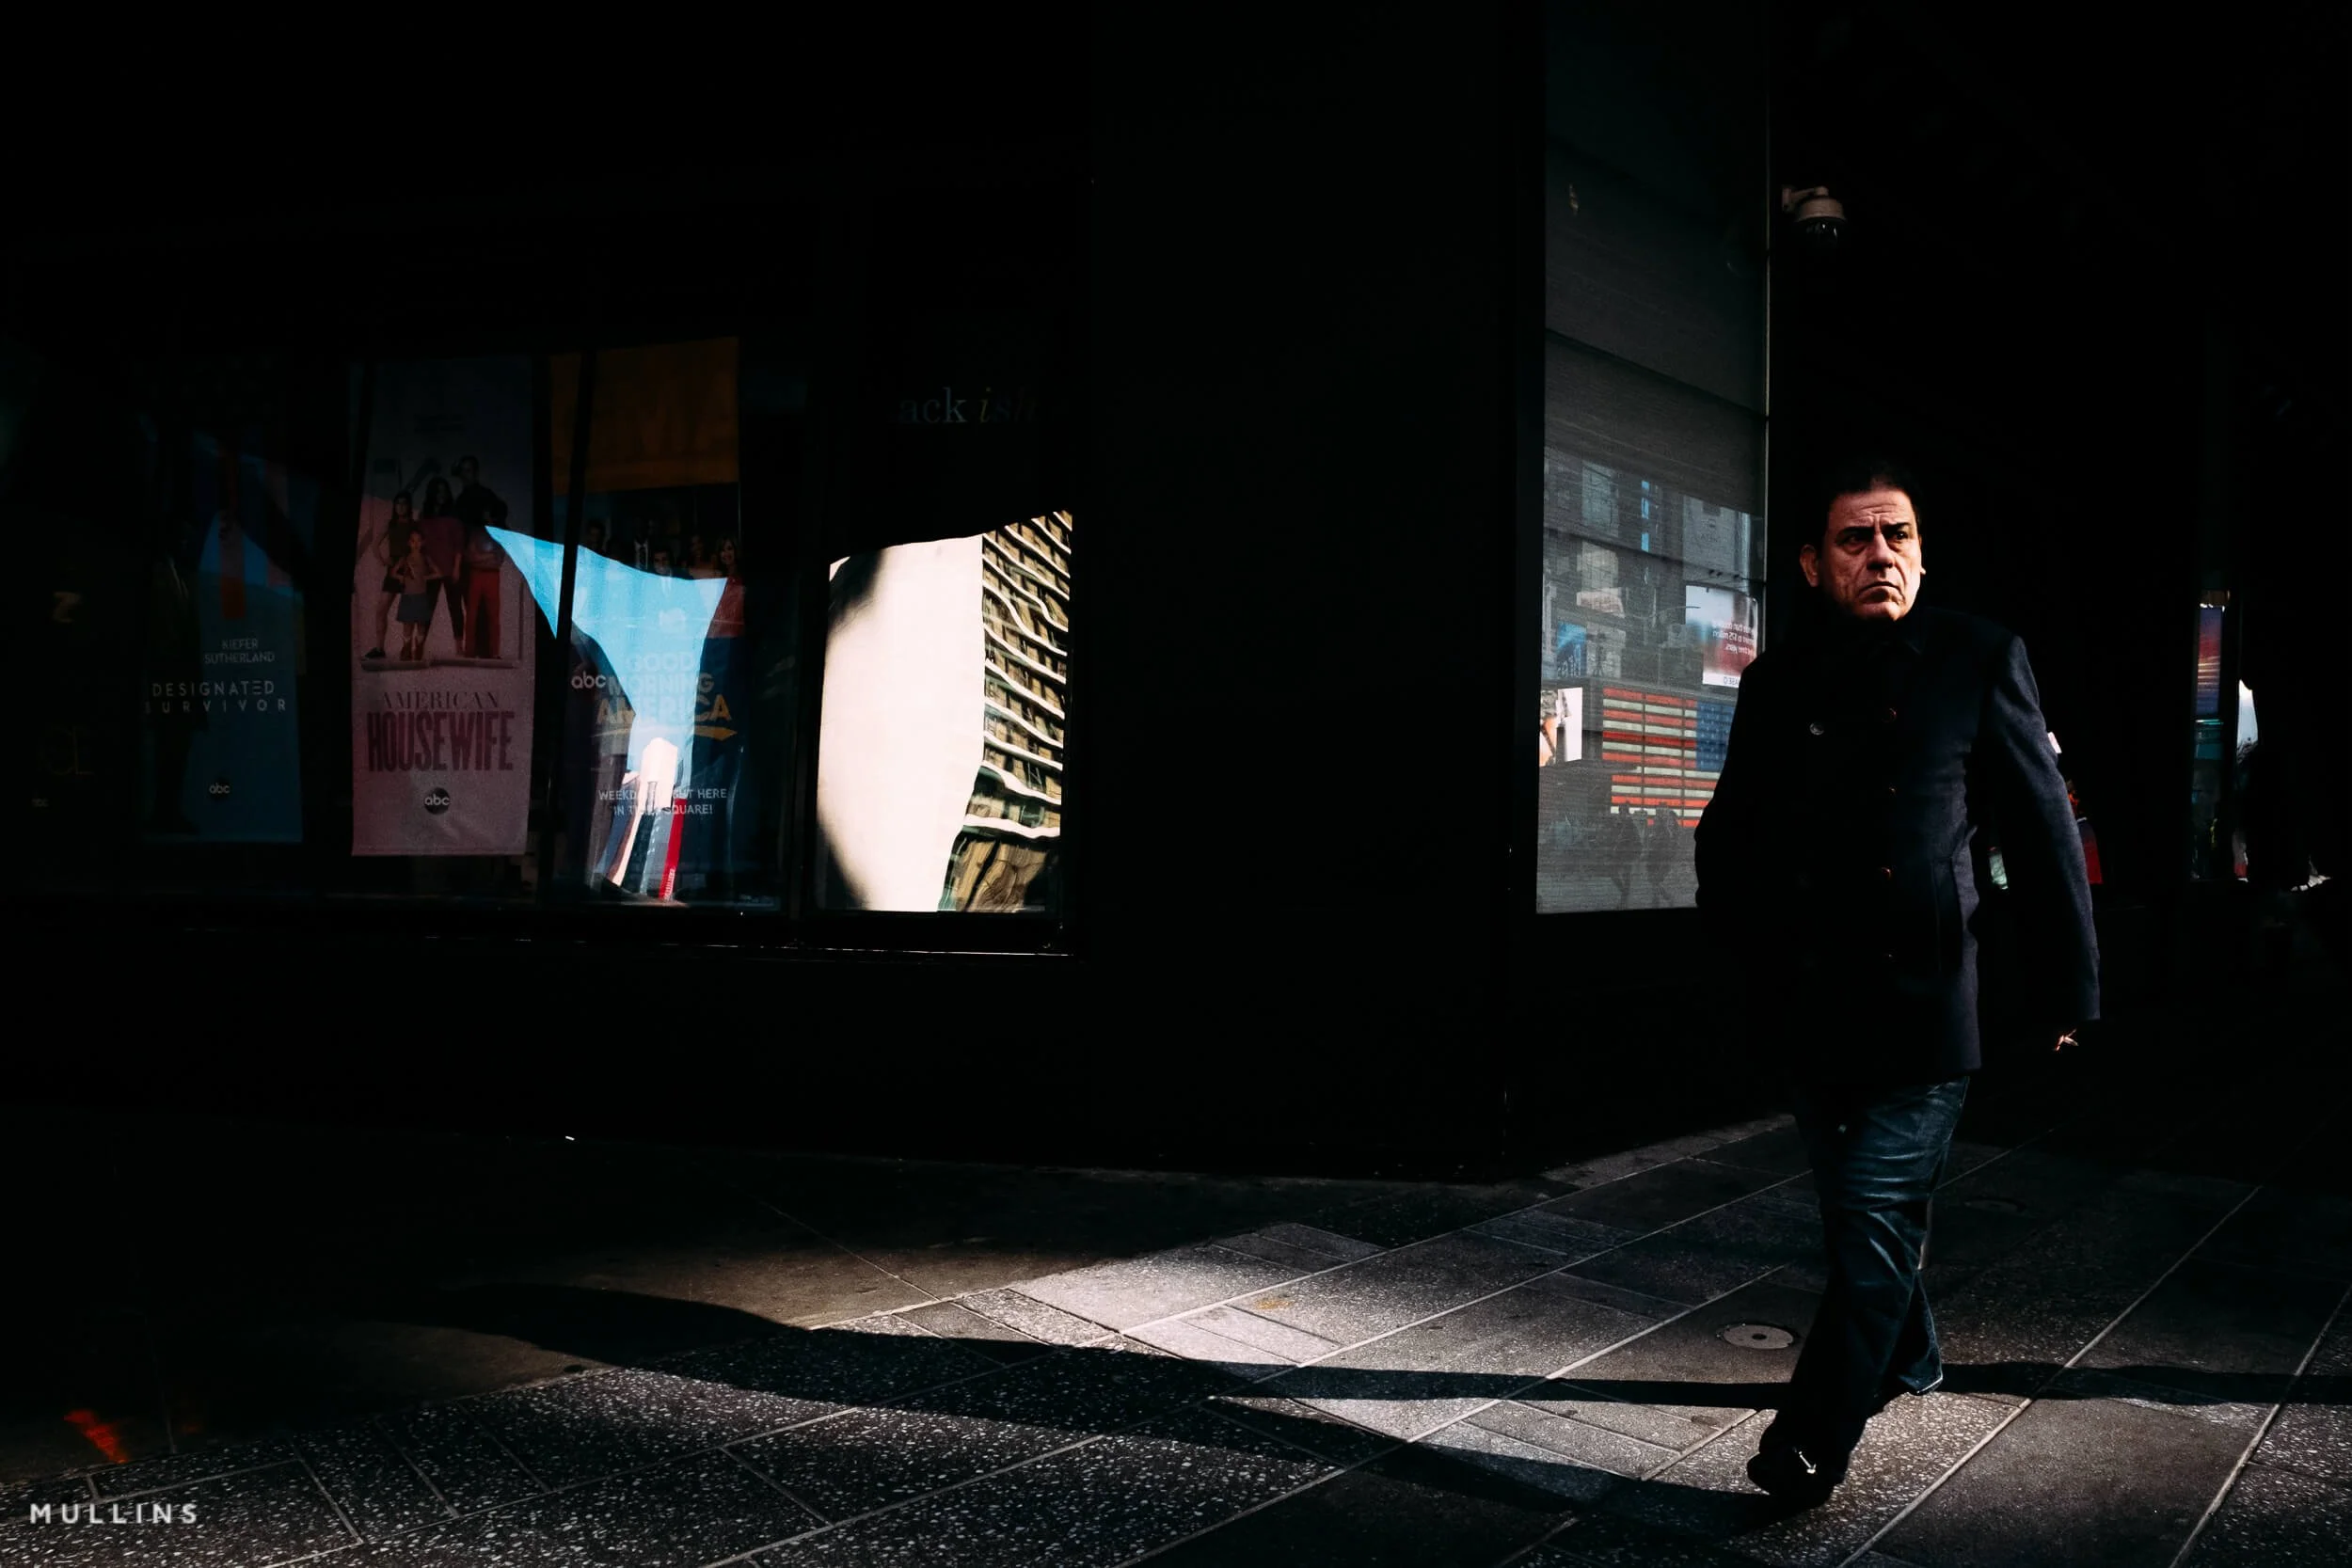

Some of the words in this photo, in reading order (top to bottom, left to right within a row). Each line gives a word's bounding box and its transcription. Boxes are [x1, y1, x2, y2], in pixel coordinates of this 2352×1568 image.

[898, 386, 969, 424] ack
[221, 638, 259, 650] KIEFER
[203, 651, 276, 665] SUTHERLAND
[628, 652, 694, 672] GOOD
[151, 680, 276, 697] DESIGNATED
[571, 671, 606, 689] abc
[607, 673, 715, 696] MORNING
[383, 691, 499, 709] AMERICAN
[366, 711, 516, 772] HOUSEWIFE
[209, 783, 230, 795] abc
[697, 788, 728, 800] HERE
[424, 794, 451, 806] abc
